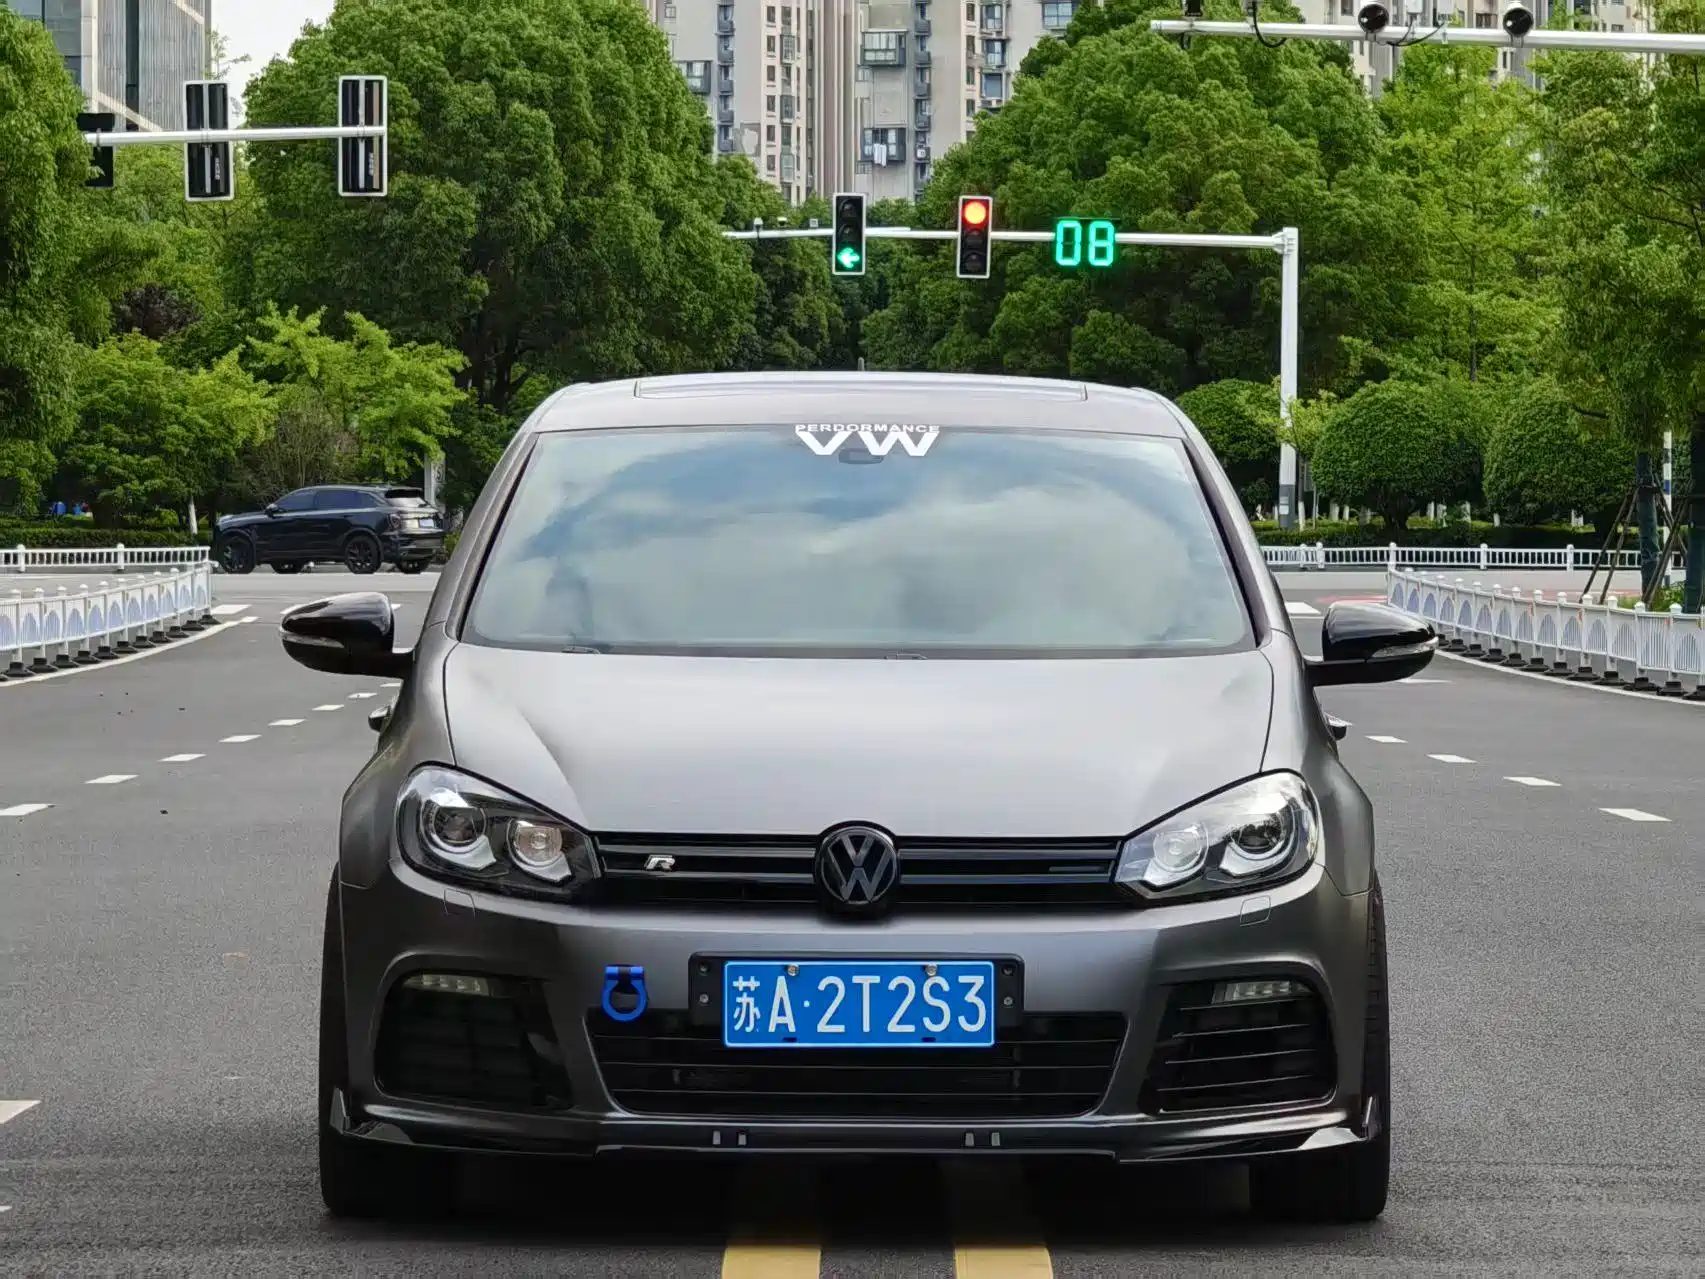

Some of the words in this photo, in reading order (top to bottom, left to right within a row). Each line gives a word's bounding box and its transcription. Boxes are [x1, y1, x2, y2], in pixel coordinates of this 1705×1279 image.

[1056, 220, 1114, 266] 08
[796, 431, 940, 456] VW
[644, 855, 675, 870] R
[823, 829, 894, 902] VW
[732, 975, 987, 1033] 苏A·2T2S3
